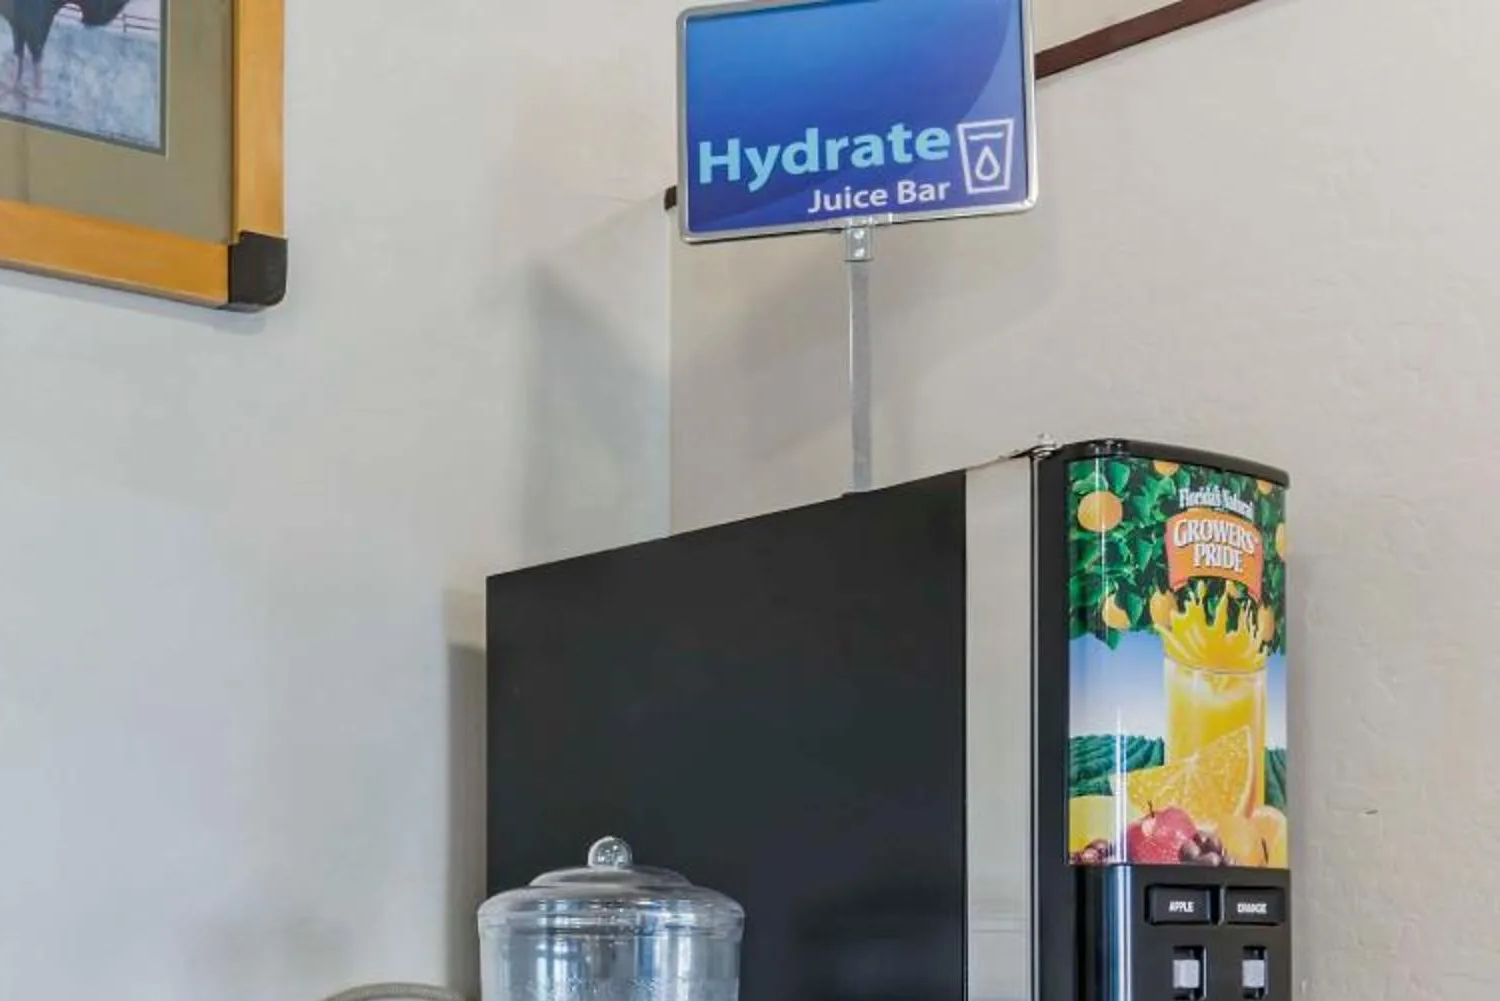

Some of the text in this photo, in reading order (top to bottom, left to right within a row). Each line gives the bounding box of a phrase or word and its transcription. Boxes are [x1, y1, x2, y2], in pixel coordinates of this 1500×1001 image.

[699, 123, 951, 192] Hydrate
[808, 180, 951, 213] Juice Bar
[1192, 543, 1243, 573] PRIDE
[1168, 901, 1195, 913] APPLE
